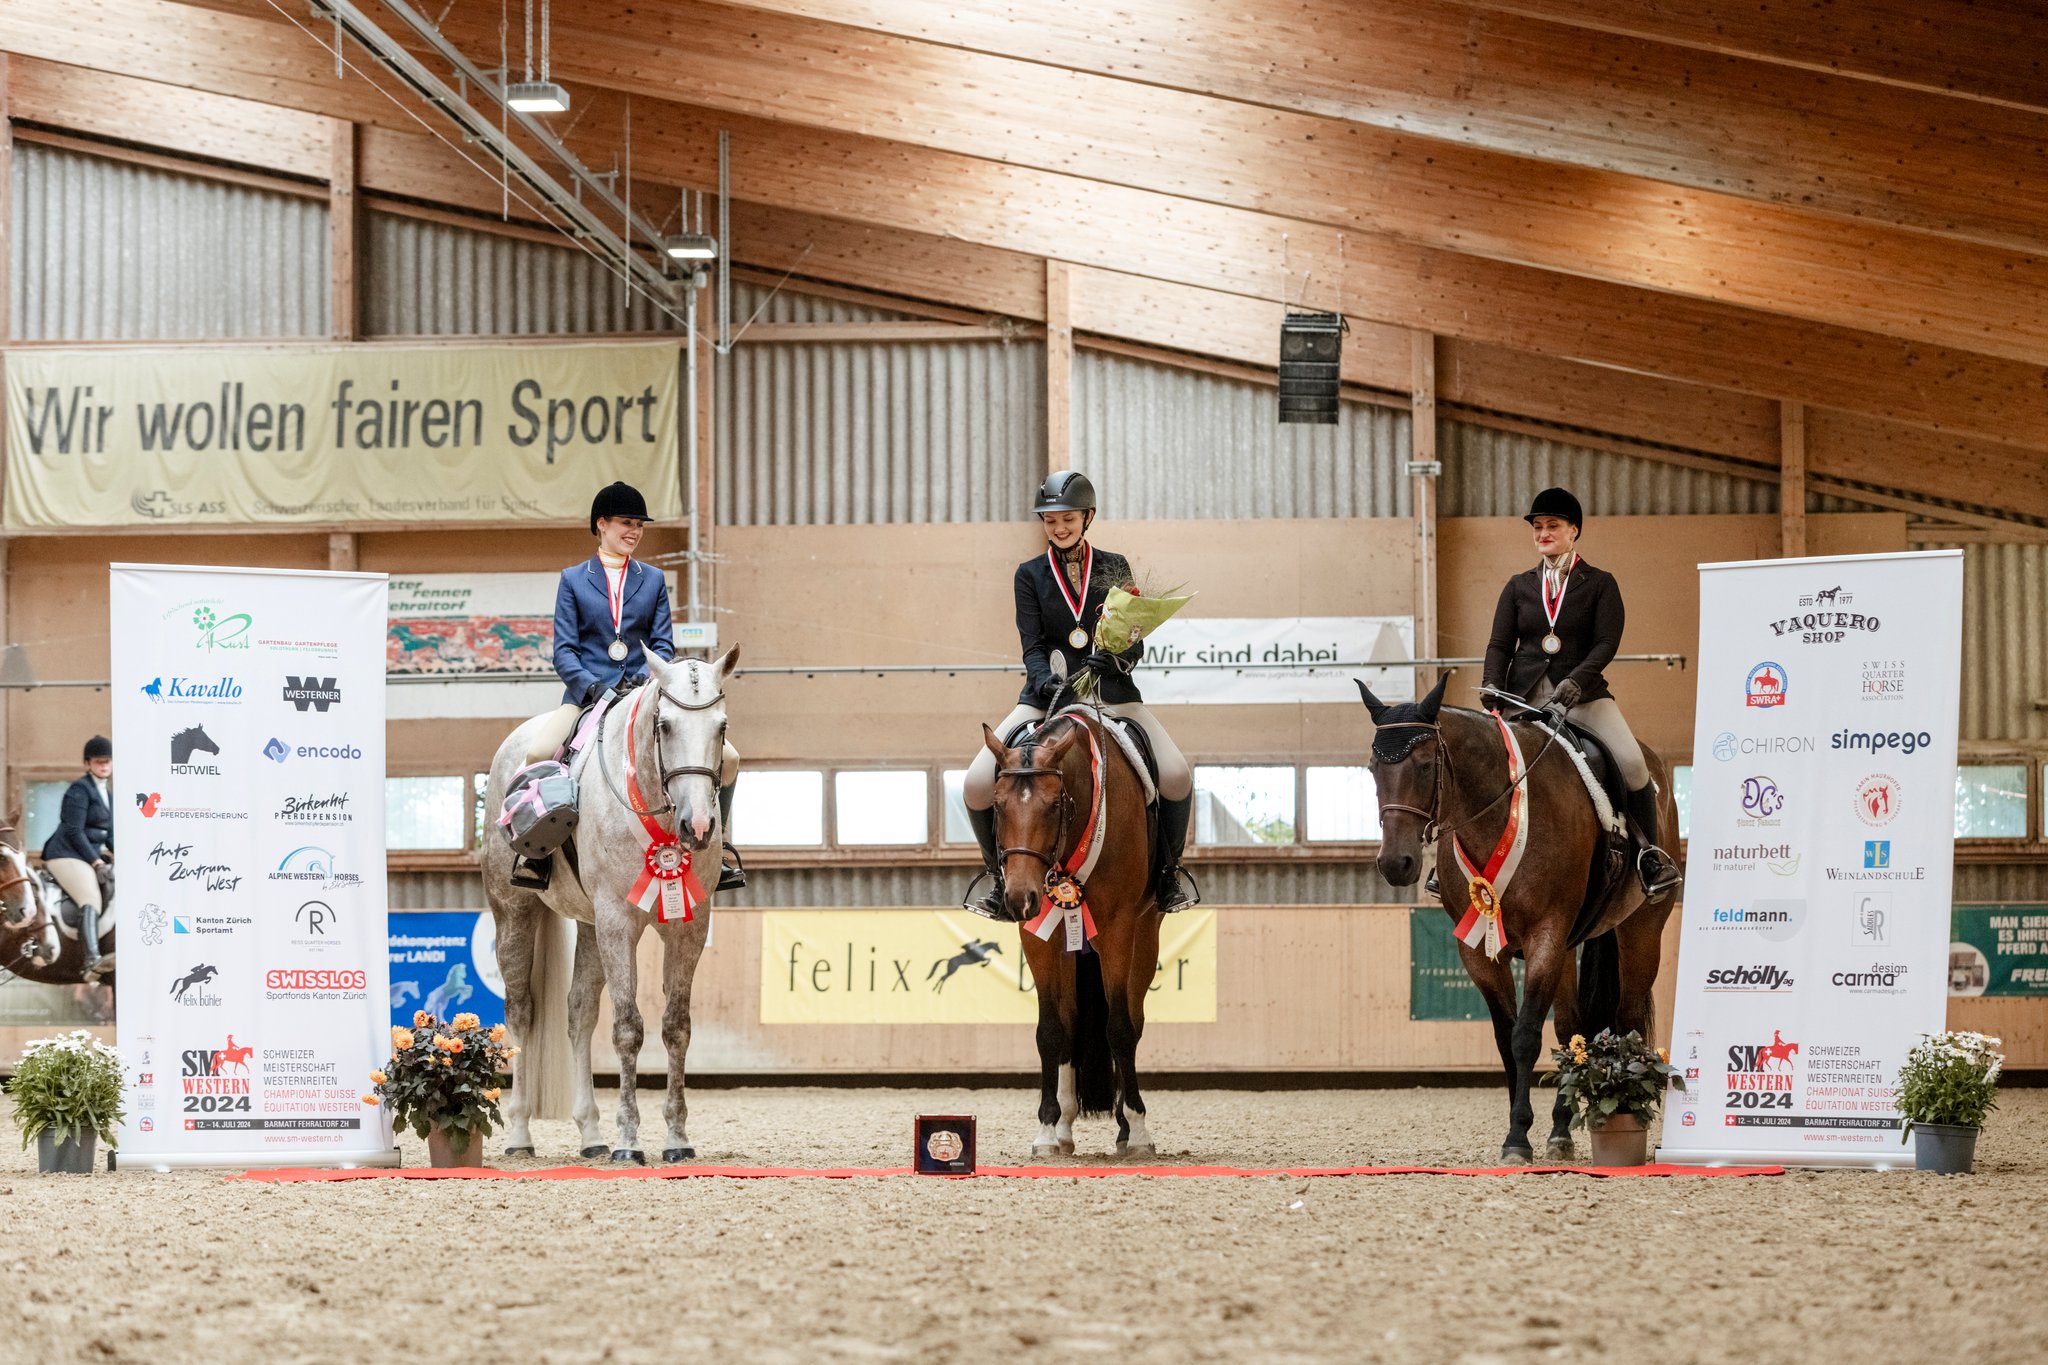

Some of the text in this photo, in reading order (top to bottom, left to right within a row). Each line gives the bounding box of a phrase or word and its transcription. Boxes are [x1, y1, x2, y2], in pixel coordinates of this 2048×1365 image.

[25, 378, 657, 464] Wir wollen fairen Sport
[388, 581, 423, 591] ster
[412, 588, 472, 598] rennen
[389, 600, 466, 611] ehraltorf
[1799, 596, 1853, 607] ESTD 1977
[1770, 612, 1881, 637] VAQUERO
[1802, 631, 1846, 644] SHOP
[1142, 644, 1186, 664] Wir
[1197, 643, 1251, 664] sind
[1862, 660, 1905, 670] SWISS
[1862, 670, 1905, 679] QUARTER
[168, 677, 242, 698] Kavallo
[284, 688, 340, 701] WESTERNER
[1861, 694, 1904, 702] ASSOCIATION
[1740, 736, 1815, 754] CHIRON
[1831, 728, 1931, 755] simpego
[297, 743, 361, 760] encodo
[171, 765, 221, 775] HOTWIEL
[160, 812, 249, 820] PFERDEVERSICHERUNG
[275, 812, 353, 822] PFERDEPENSION
[147, 841, 193, 865] Auto
[1713, 844, 1791, 860] naturbett
[169, 861, 231, 881] Zentrum
[1713, 863, 1756, 871] lit naturel
[268, 872, 360, 881] ALPINE WESTERN HORSES
[206, 875, 243, 892] West
[196, 915, 252, 924] Kanton Zürich
[310, 911, 324, 935] R
[1989, 915, 2048, 929] MAN SIEH
[196, 926, 233, 935] Sportamt
[1998, 929, 2014, 942] ES
[389, 934, 467, 949] dekompetenz
[1997, 942, 2037, 955] PFERD
[407, 950, 446, 963] LANDI
[789, 942, 911, 992] felix
[1871, 962, 1908, 978] design
[267, 970, 366, 989] SWISSLOS
[1706, 965, 1789, 990] schölly
[1832, 972, 1895, 986] carma
[2010, 968, 2048, 982] FRE
[266, 991, 367, 1001] Sportfonds Kanton Zürich
[1849, 987, 1908, 995] www.carmadesign.ch
[263, 1050, 315, 1059] SCHWEIZER
[1808, 1046, 1861, 1056] SCHWEIZER
[182, 1050, 220, 1077] SM
[1727, 1045, 1766, 1073] SM
[1807, 1060, 1882, 1070] MEISTERSCHAFT
[263, 1063, 336, 1072] MEISTERSCHAFT
[263, 1076, 338, 1086] WESTERNREITEN
[1727, 1074, 1794, 1091] WESTERN
[1807, 1073, 1882, 1084] WESTERNREITEN
[182, 1078, 250, 1095] WESTERN
[1806, 1086, 1865, 1097] CHAMPIONAT
[263, 1089, 356, 1099] CHAMPIONAT SUISSE
[1725, 1091, 1794, 1109] 2024
[183, 1095, 252, 1112] 2024
[319, 1102, 361, 1112] WESTERN
[1805, 1099, 1858, 1110] ÉQUITATION
[1804, 1118, 1837, 1127] BARMATT
[1838, 1119, 1881, 1127] FEHRALTORF
[264, 1135, 344, 1143] www.sm-western.ch
[1803, 1134, 1884, 1143] www.sm-western.ch
